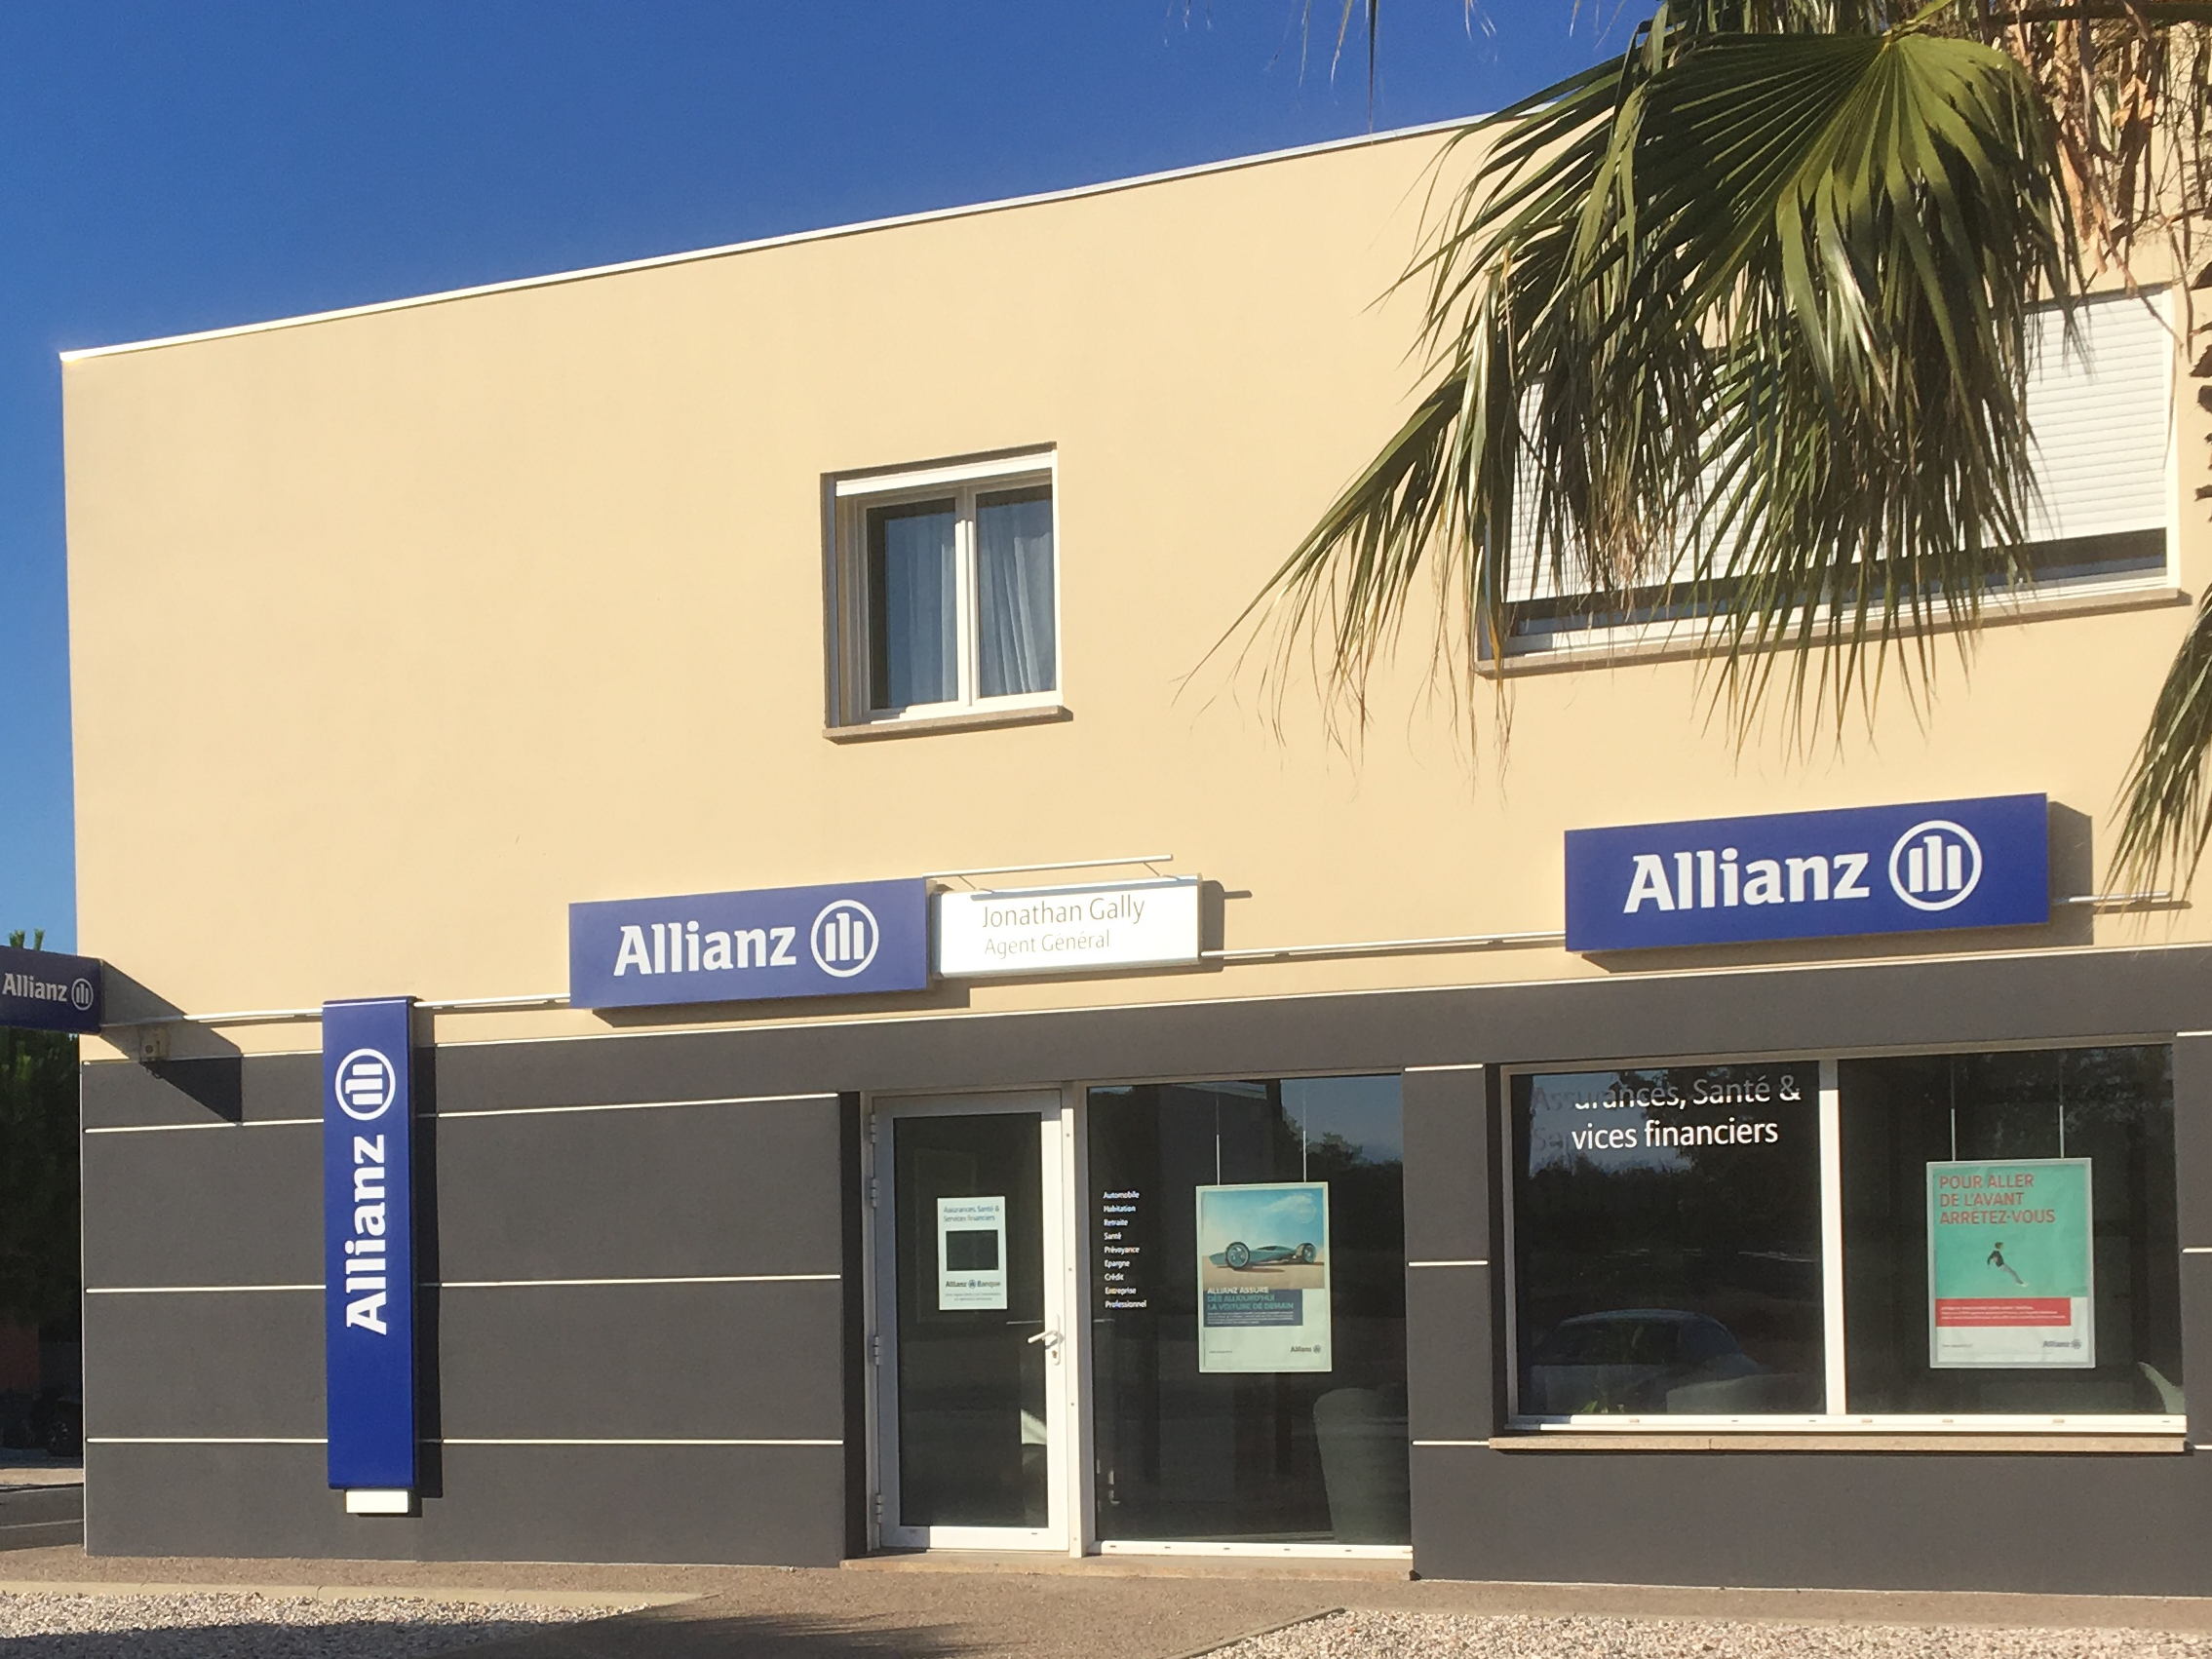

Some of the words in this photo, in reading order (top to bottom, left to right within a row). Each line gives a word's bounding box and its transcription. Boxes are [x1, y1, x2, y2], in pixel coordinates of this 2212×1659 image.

[1622, 847, 1871, 913] Allianz
[982, 901, 1083, 928] Jonathan
[1089, 894, 1145, 925] Gally
[612, 921, 797, 977] Allianz
[984, 938, 1036, 960] Agent
[1041, 929, 1110, 952] Général
[2, 972, 68, 1002] Allianz
[1691, 1074, 1770, 1105] Santé
[1779, 1074, 1802, 1102] &
[1644, 1116, 1779, 1147] financiers
[1939, 1175, 1983, 1189] POUR
[1987, 1173, 2035, 1188] ALLER
[1103, 1190, 1140, 1199] Automobile
[1940, 1193, 1960, 1208] DE
[1963, 1191, 2025, 1207] L'AVANT
[345, 1134, 387, 1335] Allianz
[977, 1280, 1001, 1289] Banque
[1105, 1287, 1137, 1295] Entreprise
[1239, 1286, 1269, 1294] ASSURE
[1105, 1299, 1147, 1308] Professionnel
[1218, 1302, 1252, 1311] VOITURE
